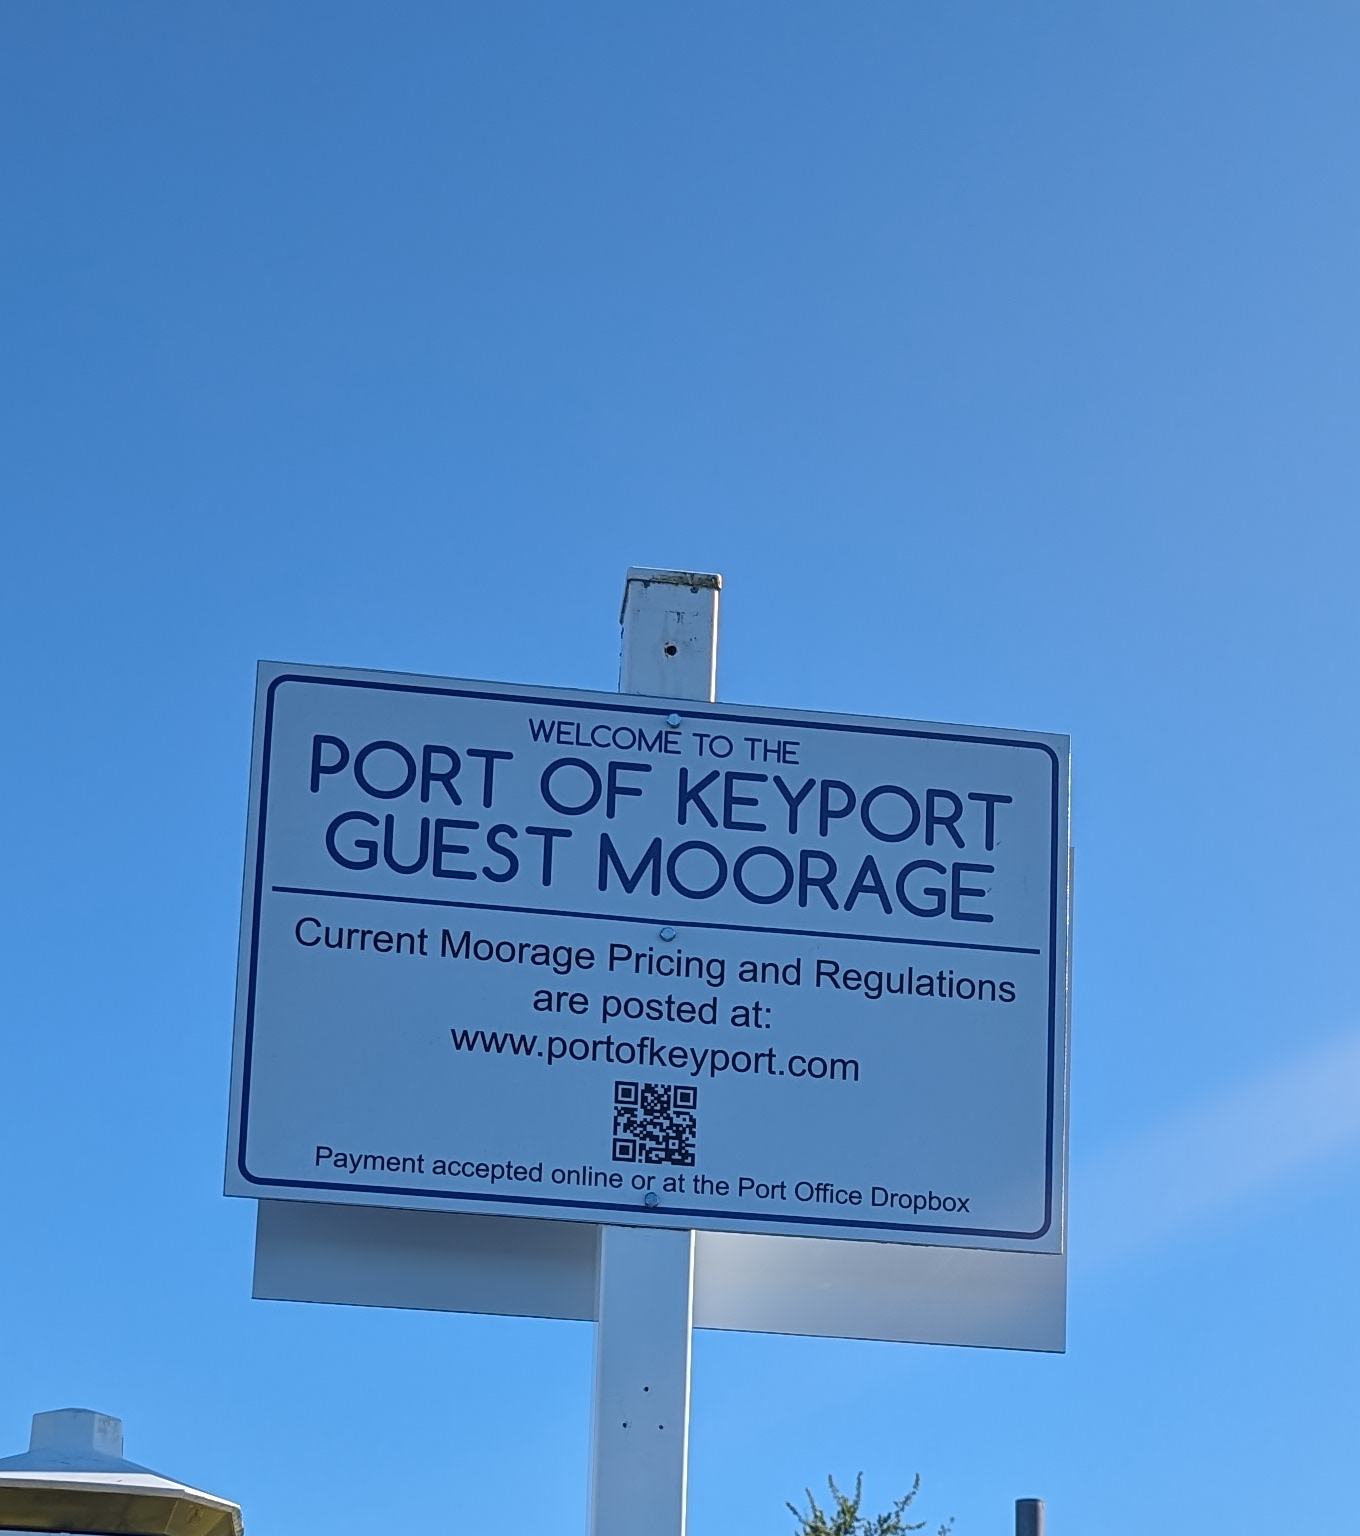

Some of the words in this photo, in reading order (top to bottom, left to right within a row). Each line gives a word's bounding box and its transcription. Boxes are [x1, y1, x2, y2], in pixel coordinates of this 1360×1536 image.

[528, 718, 683, 755] WELCOME
[691, 732, 734, 759] TO
[743, 736, 801, 766] THE
[309, 734, 514, 809] PORT
[540, 757, 653, 820] OF
[677, 766, 1013, 852] KEYPORT
[325, 810, 573, 887] GUEST
[597, 832, 995, 924] MOORAGE
[294, 916, 429, 957] Current
[440, 928, 596, 976] Moorage
[608, 942, 726, 988] Pricing
[738, 957, 802, 986] and
[815, 959, 1016, 1003] Regulations
[533, 989, 589, 1015] are
[601, 993, 718, 1025] posted
[730, 1000, 771, 1029] at:
[450, 1028, 859, 1082] www.portofkeyport.com
[315, 1145, 425, 1175] Payment
[431, 1159, 543, 1185] accepted
[551, 1165, 624, 1189] online
[631, 1174, 657, 1191] or
[662, 1173, 686, 1194] at
[692, 1173, 730, 1197] the
[738, 1176, 787, 1201] Port
[794, 1181, 863, 1206] Office
[871, 1186, 971, 1215] Dropbox
